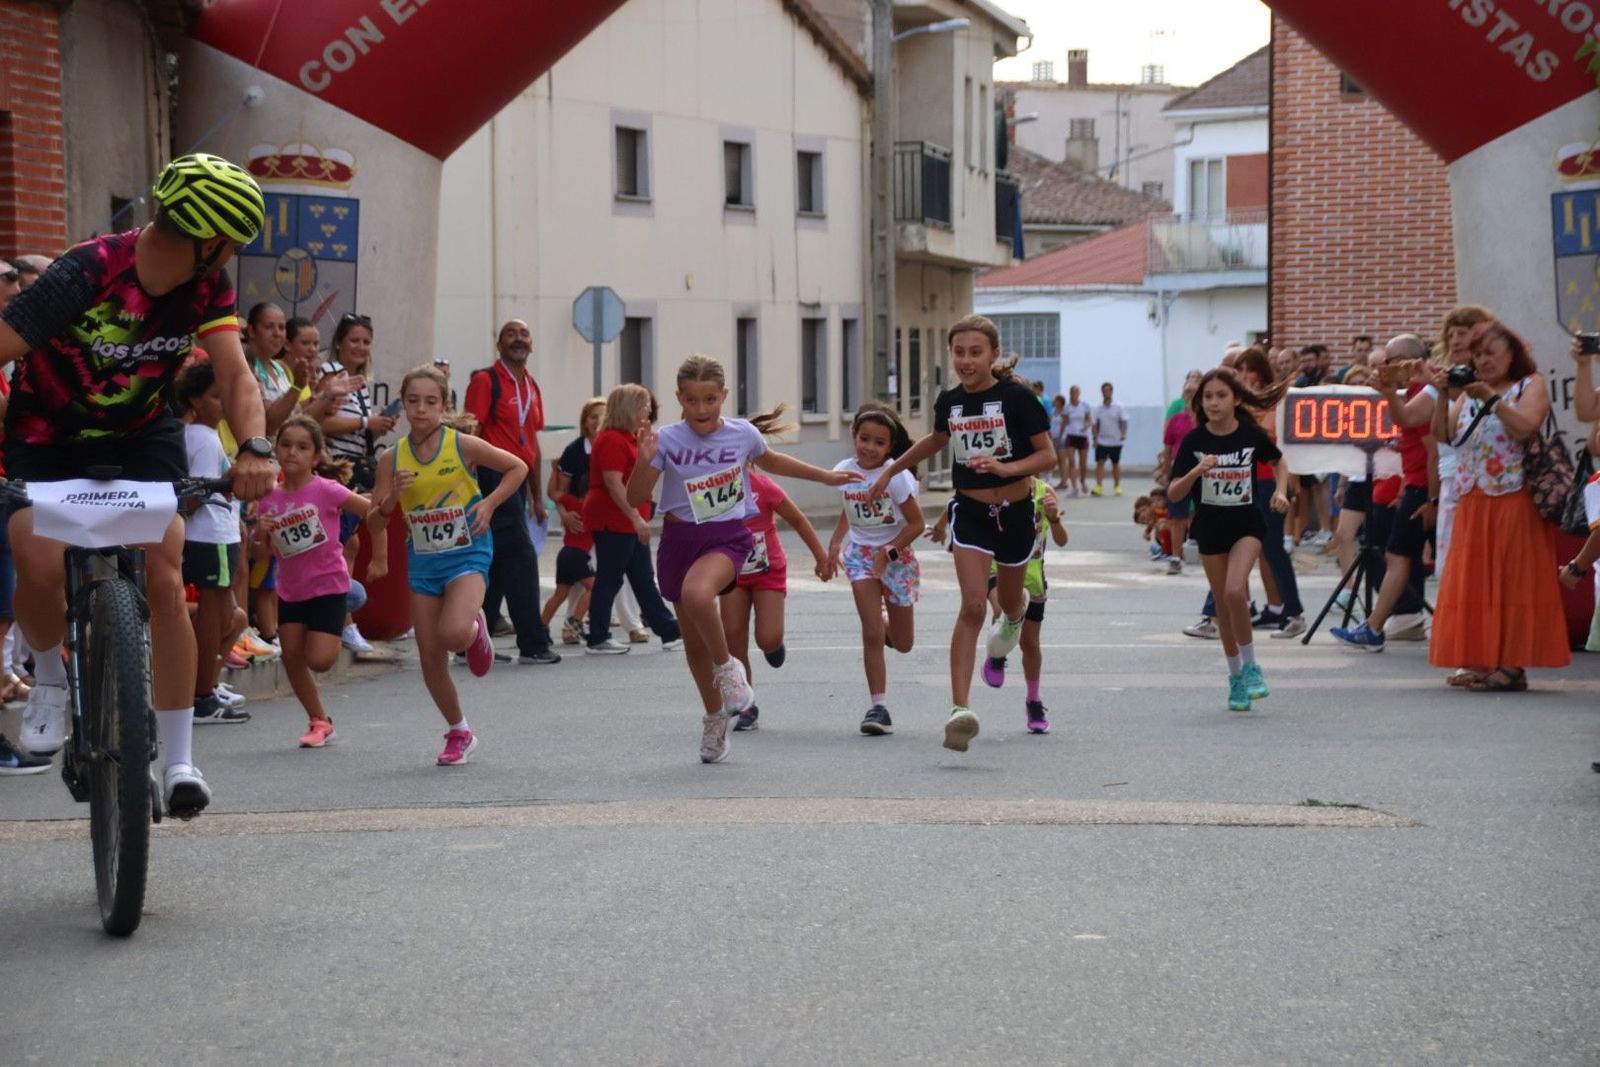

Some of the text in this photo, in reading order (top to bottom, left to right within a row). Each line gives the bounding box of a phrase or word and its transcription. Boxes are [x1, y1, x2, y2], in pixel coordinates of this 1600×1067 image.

[299, 16, 385, 92] CON
[92, 337, 129, 359] los
[961, 431, 995, 451] 145
[663, 447, 738, 466] NIKE
[66, 490, 139, 501] PRIMERA
[704, 482, 738, 508] 144
[1213, 481, 1243, 497] 146
[854, 501, 884, 519] 152
[281, 523, 312, 545] 138
[422, 522, 455, 543] 149
